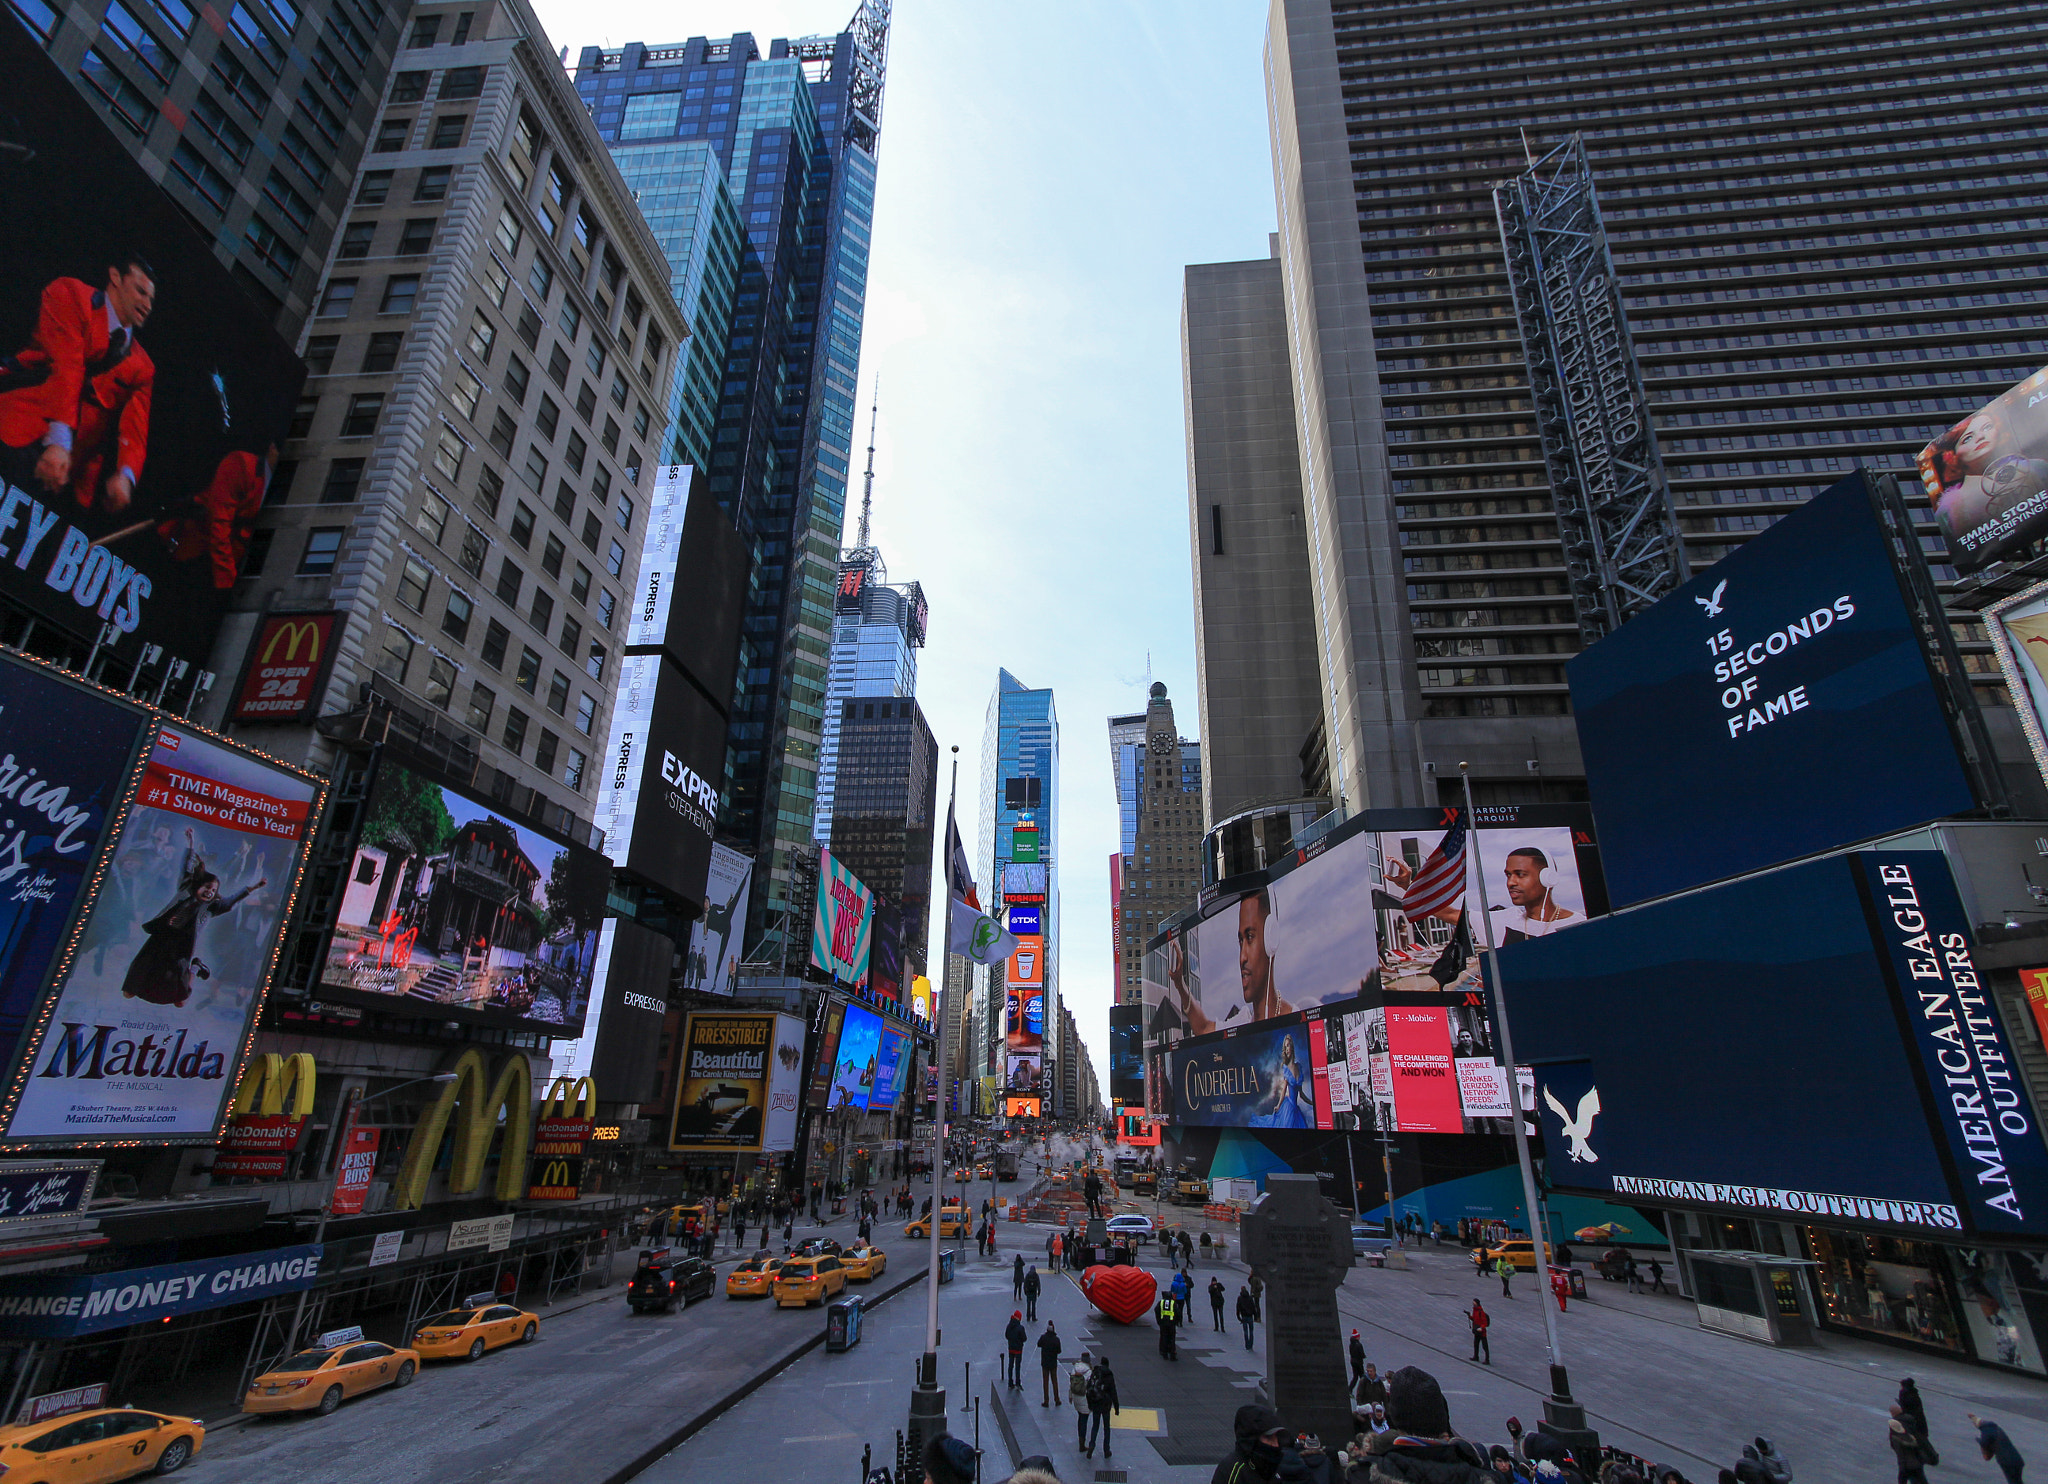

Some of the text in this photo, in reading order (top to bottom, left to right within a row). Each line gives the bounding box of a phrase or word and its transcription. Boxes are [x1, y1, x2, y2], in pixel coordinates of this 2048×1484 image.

[1580, 273, 1640, 444] OUTFITTERS
[1543, 260, 1617, 501] AMERICAN EAGLE
[2001, 490, 2048, 521] STONE
[1966, 541, 1977, 551] IS
[45, 525, 152, 633] BOYS
[644, 572, 660, 622] EXPRESS
[1706, 627, 1733, 656] 15
[1714, 595, 1855, 683] SECONDS
[260, 666, 309, 678] OPEN
[259, 680, 299, 698] 24
[628, 682, 642, 714] CURRY
[1721, 676, 1759, 709] OF
[242, 699, 305, 712] HOURS
[1727, 685, 1809, 738] FAME
[159, 735, 178, 748] RSC
[614, 733, 633, 790] EXPRESS
[168, 773, 288, 817] TIME Magazine's
[148, 788, 296, 836] #1 Show of the Year!
[1306, 836, 1327, 850] MARRIOTT
[1306, 845, 1326, 860] MARQUIS
[712, 850, 745, 870] ingsman
[16, 874, 56, 888] A New
[10, 888, 56, 903] Musical
[1004, 894, 1045, 902] TOSHIBA
[831, 904, 860, 967] RISE
[349, 960, 400, 980] Beautiful
[2028, 986, 2043, 1001] THE
[121, 1020, 170, 1031] Roald Dahl's
[1939, 932, 2027, 1135] OUTFITTERS
[694, 1028, 769, 1045] IRRESISTIBLE!
[1879, 864, 2023, 1220] AMERICAN EAGLE
[39, 1022, 225, 1080] Matilda
[691, 1050, 764, 1069] Beautiful
[1404, 1054, 1449, 1062] CHALLENGED
[691, 1070, 762, 1080] The Carole King Musical
[1401, 1069, 1446, 1077] AND WON
[106, 1081, 164, 1091] THE MUSICAL
[1185, 1060, 1260, 1110] CINDERELLA
[1212, 1103, 1231, 1112] MARCH 13
[65, 1115, 176, 1124] MatildaTheMusical.com
[538, 1124, 590, 1132] McDonald's
[226, 1126, 297, 1138] McDonald's
[252, 1162, 282, 1170] HOURS
[341, 1151, 378, 1169] JERSEY
[25, 1174, 72, 1197] A New
[344, 1168, 371, 1184] BOYS
[18, 1190, 70, 1214] Musical
[1613, 1176, 1962, 1230] AMERICAN EAGLE OUTFITTERS
[82, 1256, 321, 1318] MONEY CHANGE
[36, 1387, 103, 1418] BROADWAY.COM
